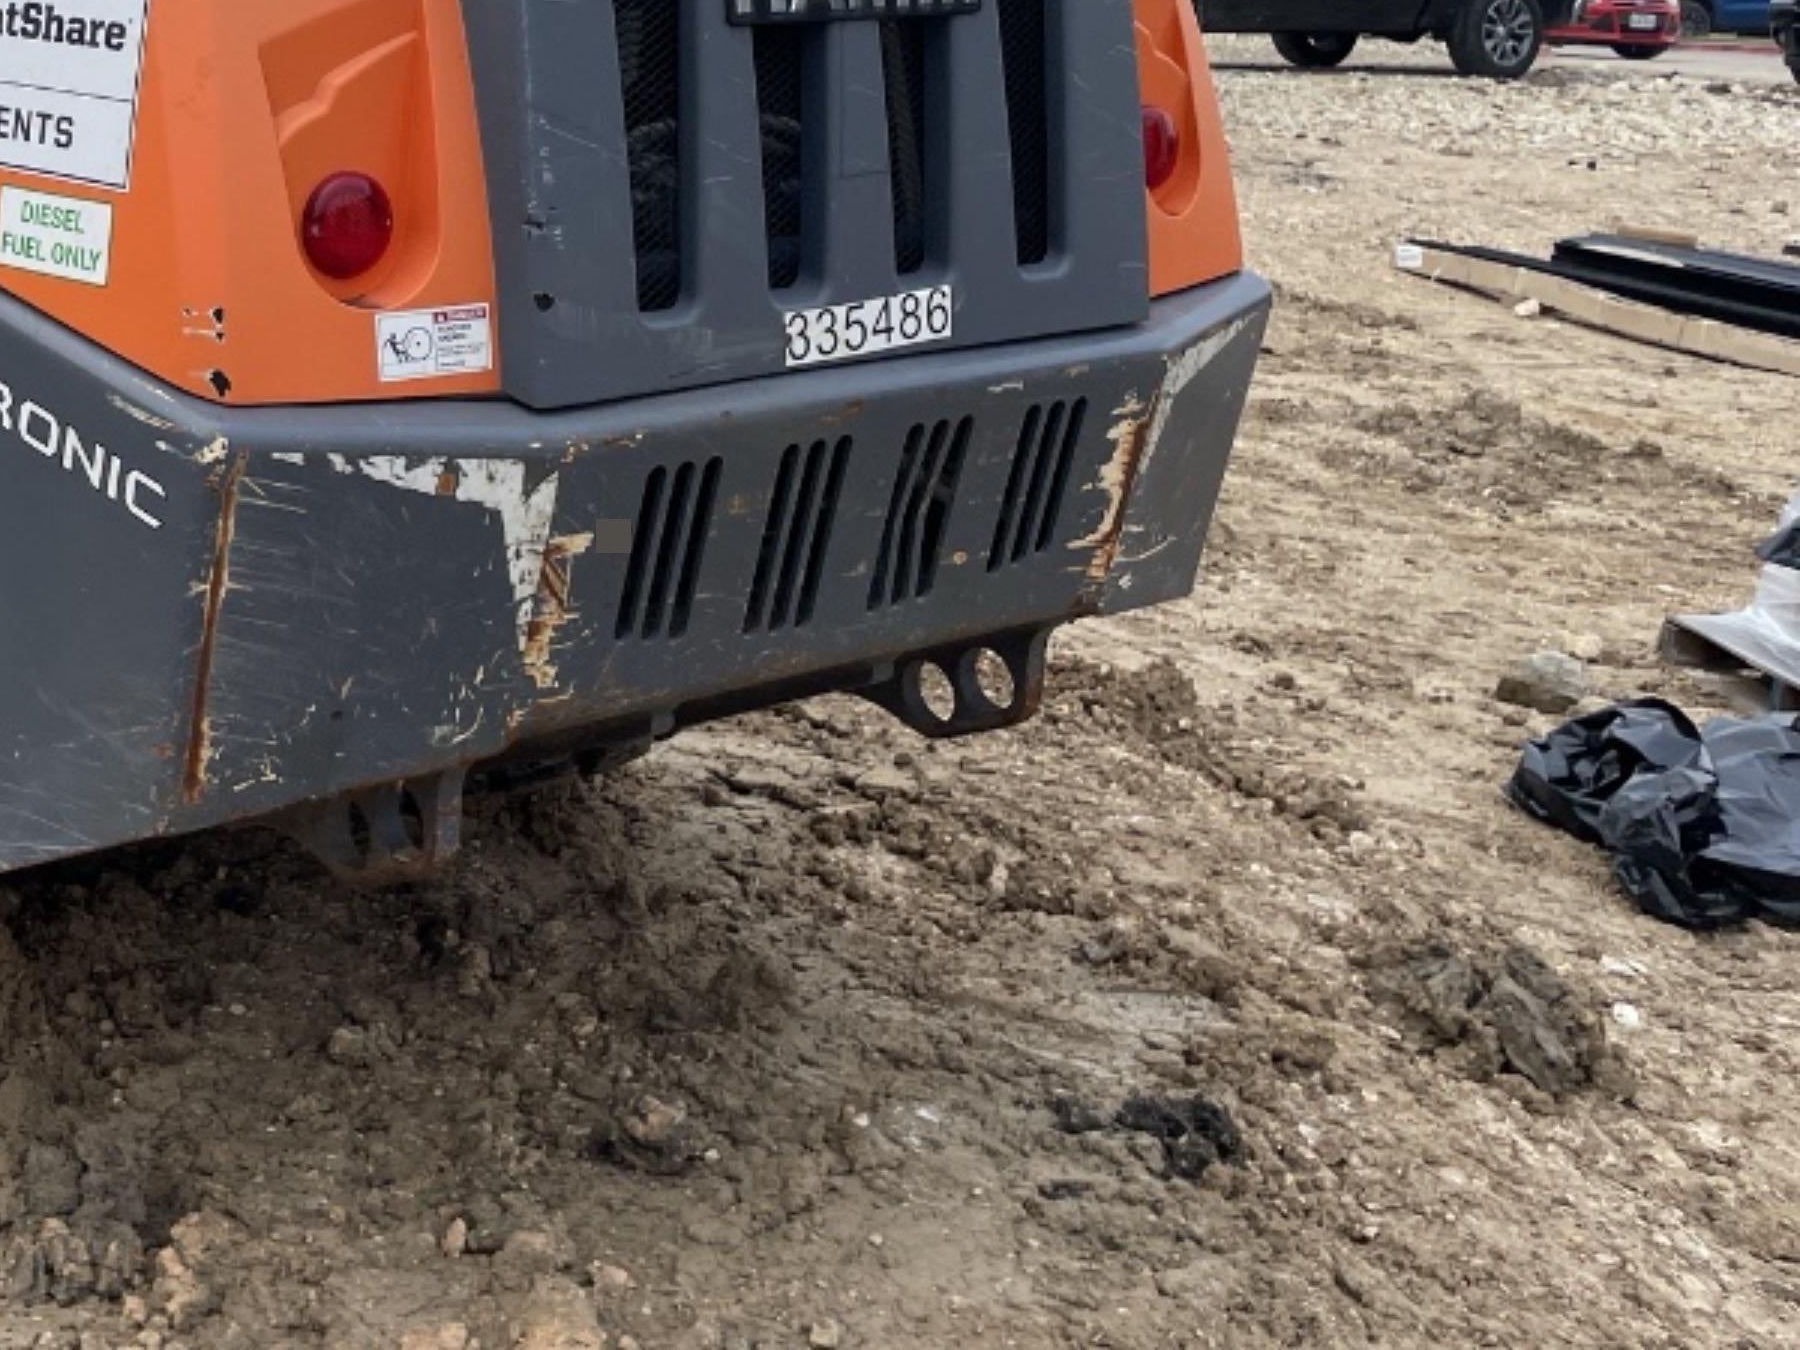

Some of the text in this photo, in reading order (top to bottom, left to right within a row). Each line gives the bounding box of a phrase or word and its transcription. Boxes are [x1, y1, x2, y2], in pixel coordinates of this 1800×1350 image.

[20, 200, 85, 235] DIESEL
[2, 231, 103, 272] FUEL ONLY
[787, 288, 949, 361] 335486
